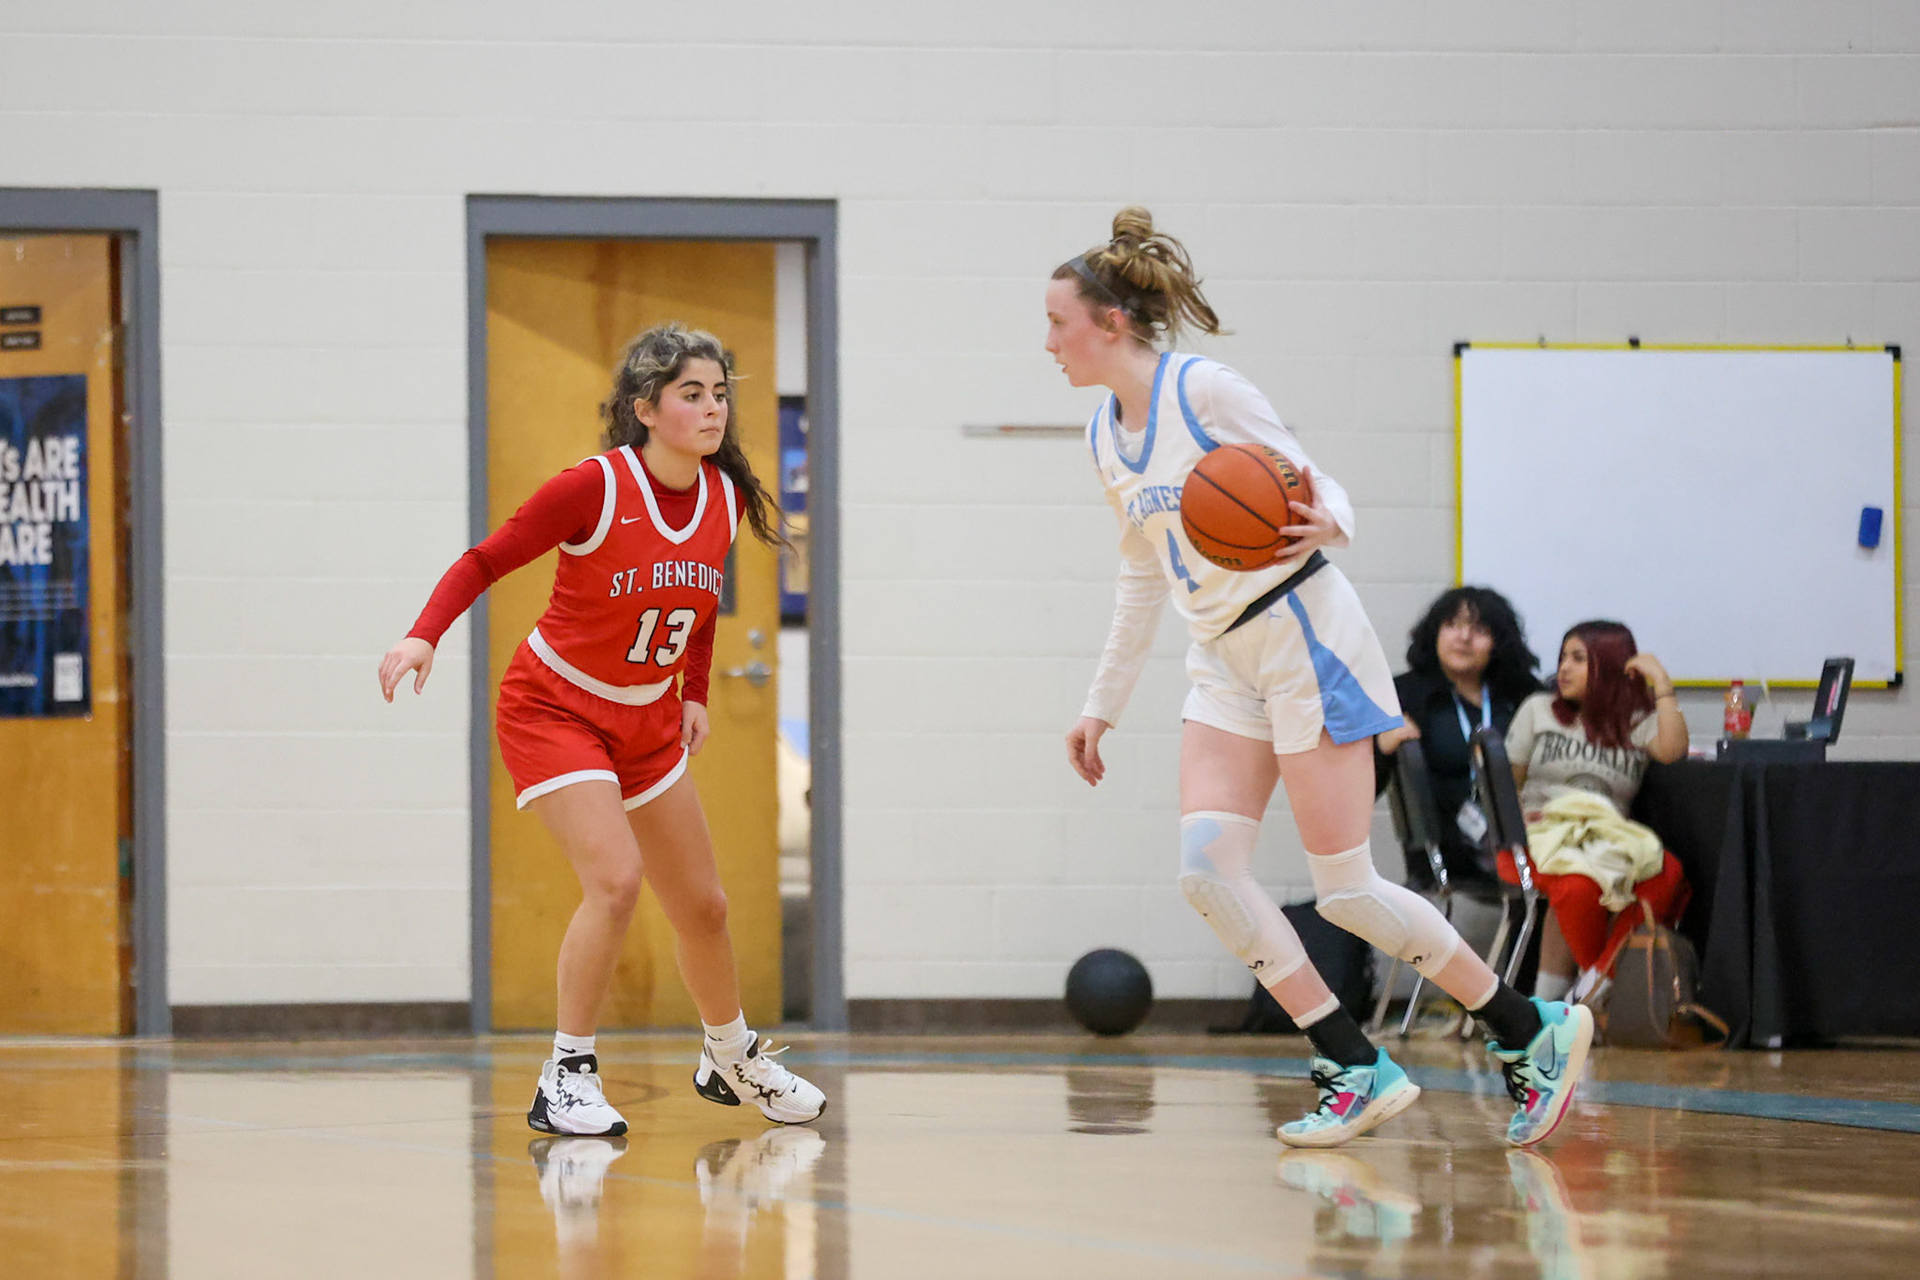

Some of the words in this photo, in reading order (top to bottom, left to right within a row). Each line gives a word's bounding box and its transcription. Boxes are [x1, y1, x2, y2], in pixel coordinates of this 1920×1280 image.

[22, 436, 80, 481] ARE
[609, 567, 644, 598] ST.
[1165, 527, 1203, 594] 4
[625, 607, 697, 667] 13
